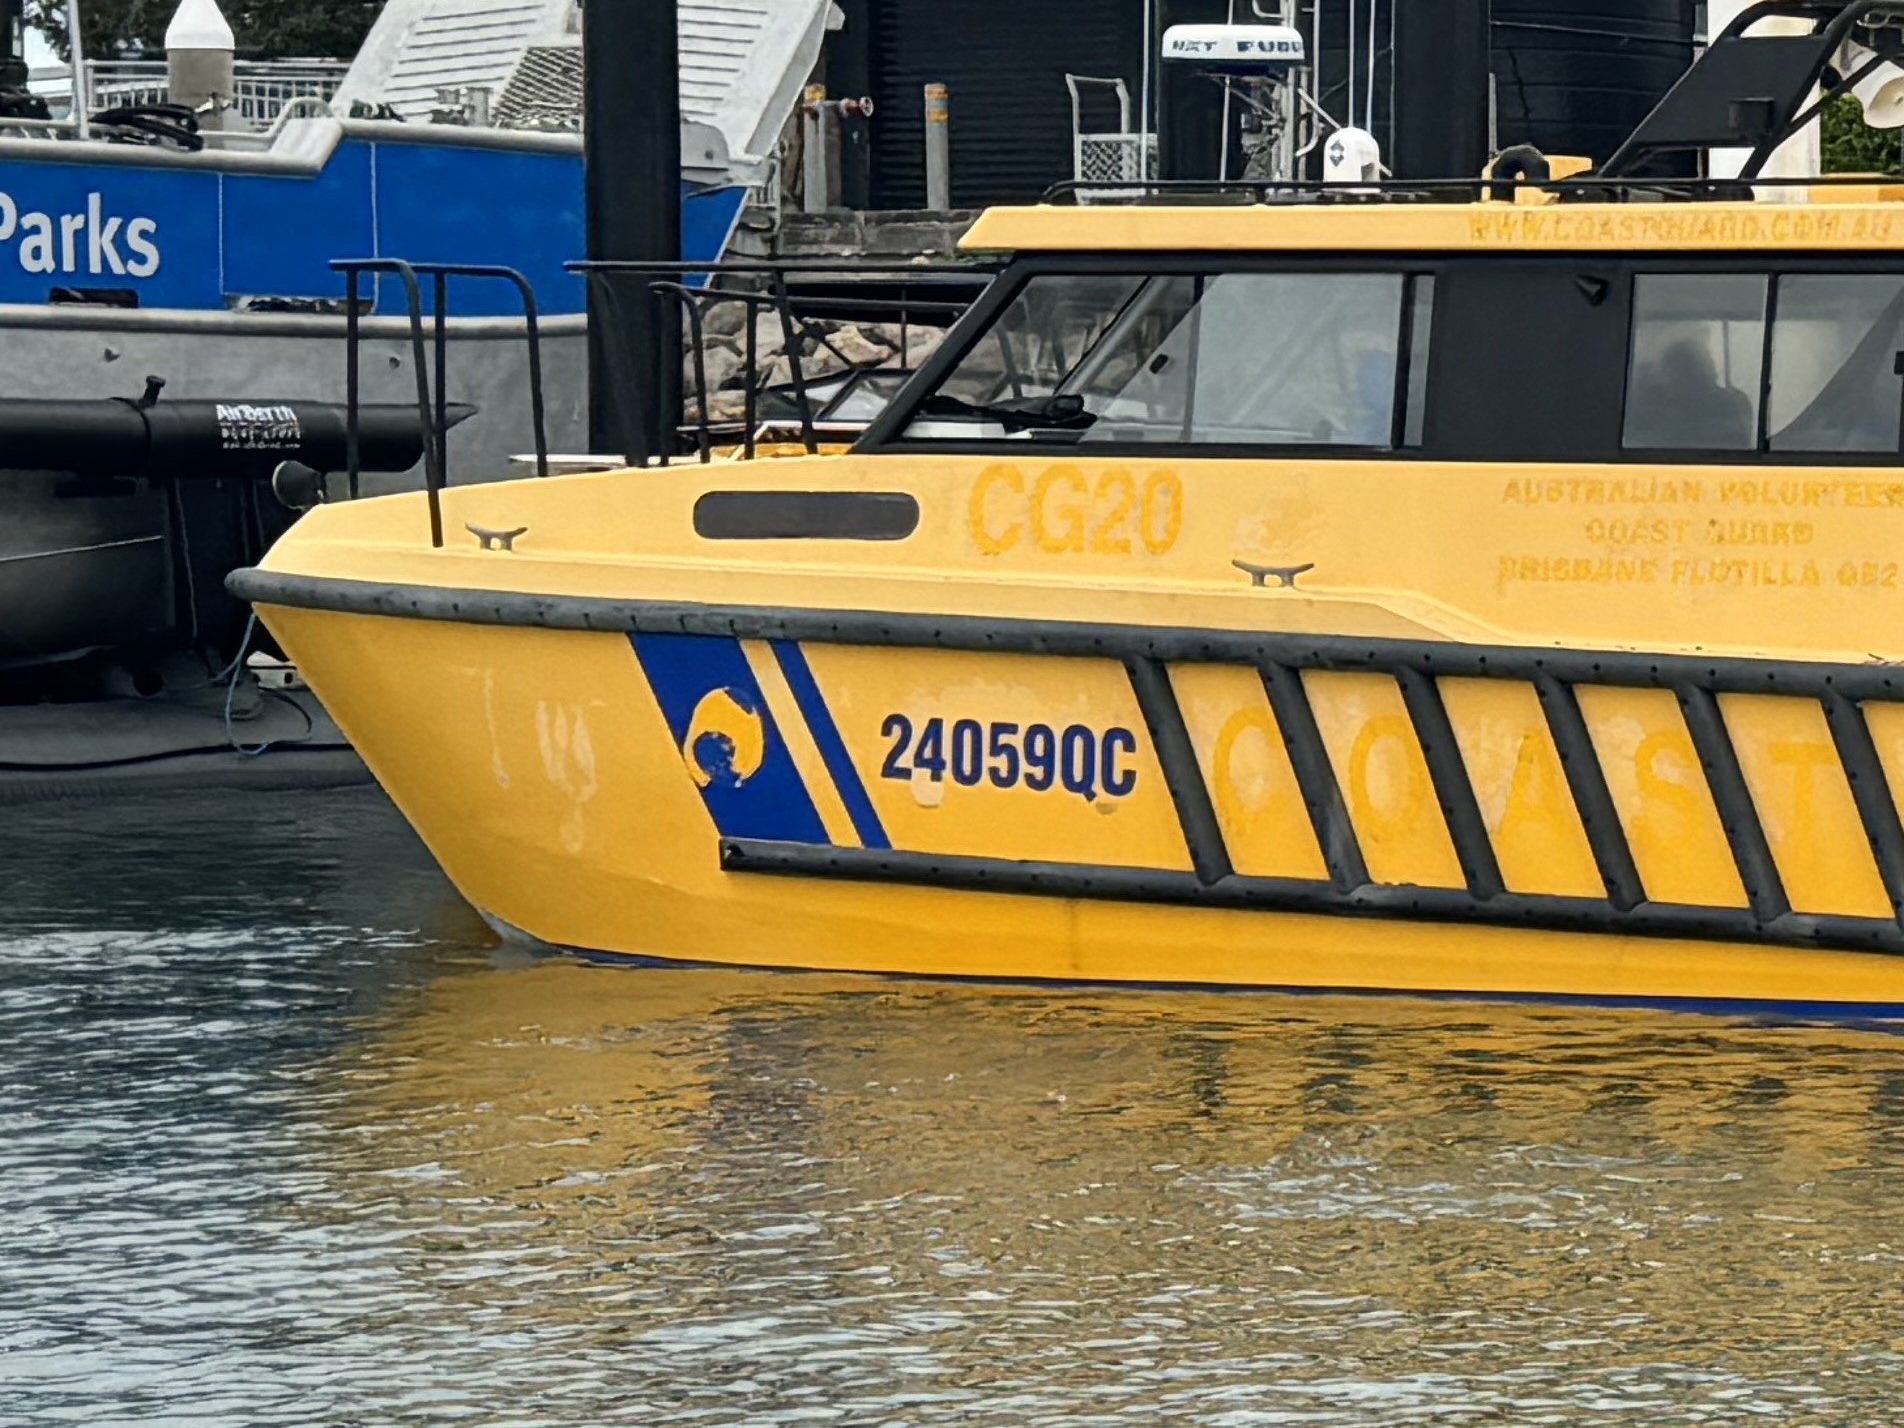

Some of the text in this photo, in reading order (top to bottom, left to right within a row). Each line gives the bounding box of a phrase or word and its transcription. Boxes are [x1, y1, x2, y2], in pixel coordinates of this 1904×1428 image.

[1502, 478, 1702, 505] AUSTRALIAN
[968, 463, 1183, 556] CG20
[1585, 517, 1815, 546] COAST GUARD
[1499, 555, 1660, 584] BRISBANE
[1670, 559, 1821, 588] FLOTILLA
[880, 713, 1137, 803] 24059QC
